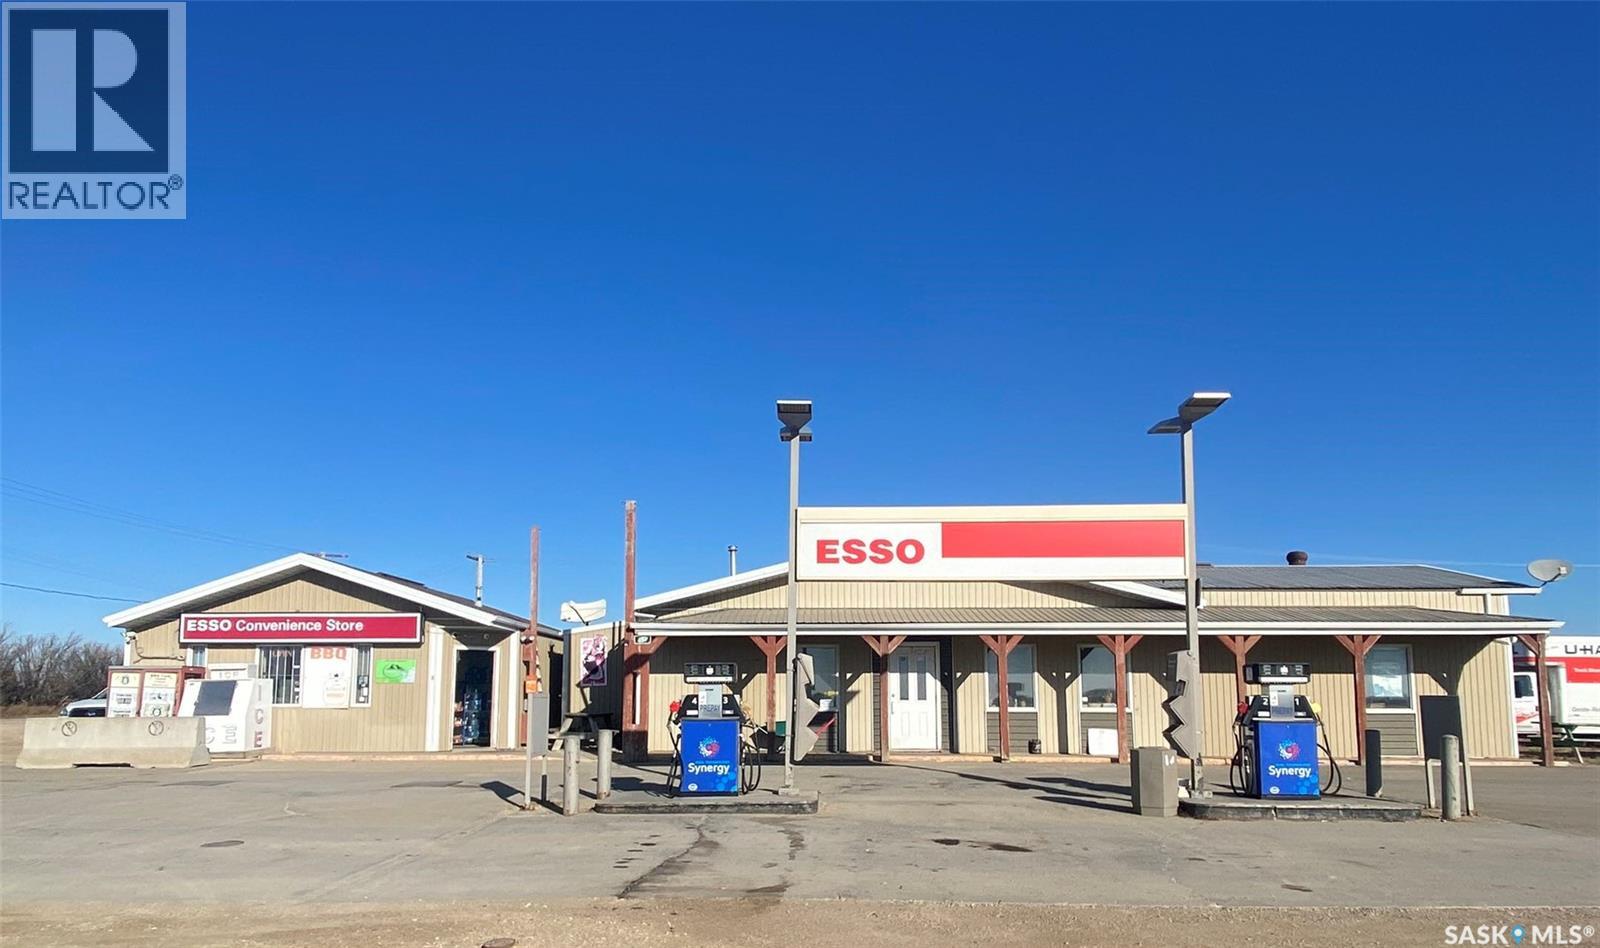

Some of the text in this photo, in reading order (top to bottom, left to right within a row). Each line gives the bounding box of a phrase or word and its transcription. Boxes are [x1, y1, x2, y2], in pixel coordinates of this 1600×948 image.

[816, 538, 925, 564] ESSO
[187, 618, 364, 632] ESSO Convenience Store
[310, 647, 348, 660] BBQ
[688, 762, 730, 775] Synergy
[1268, 765, 1311, 778] Synergy
